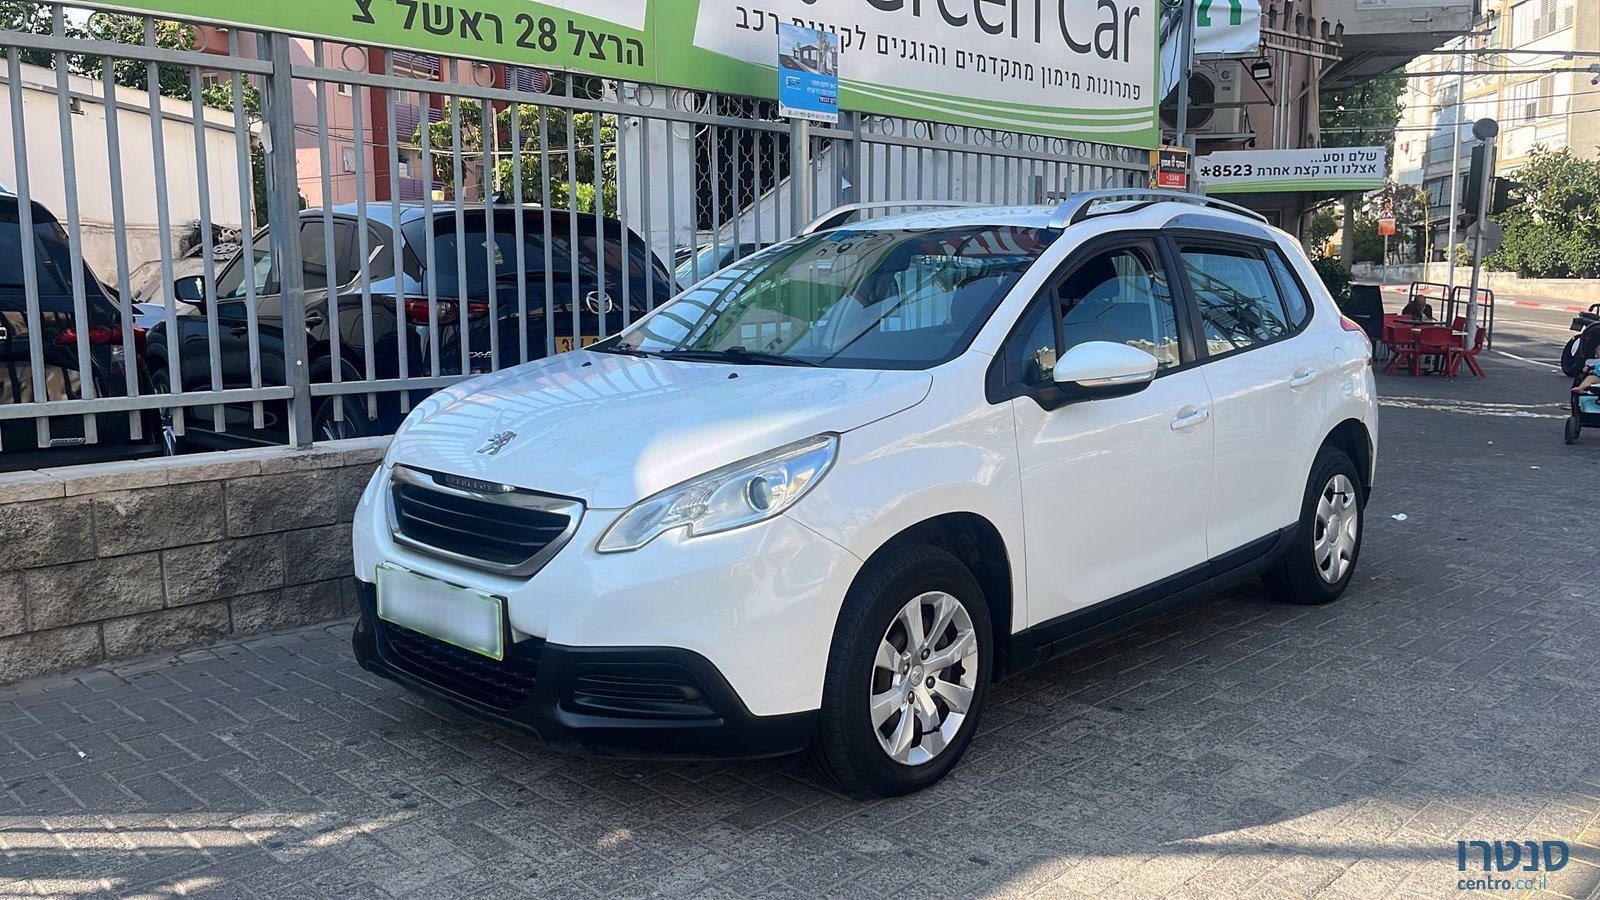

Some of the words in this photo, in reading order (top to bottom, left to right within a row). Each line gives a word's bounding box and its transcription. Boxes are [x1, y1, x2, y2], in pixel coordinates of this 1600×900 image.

[515, 13, 558, 52] 28
[736, 6, 780, 35] רכב
[1058, 0, 1140, 63] Car
[567, 19, 644, 67] הרצל
[877, 34, 946, 66] והוגנים
[955, 49, 1034, 82] מתקדמים
[1041, 66, 1080, 90] מימון
[1086, 75, 1141, 101] פתרונות
[1342, 162, 1377, 175] אצלנו
[1349, 151, 1377, 162] שלם
[1256, 166, 1290, 176] אחרת
[1294, 165, 1320, 177] קצת
[1324, 165, 1338, 175] זה
